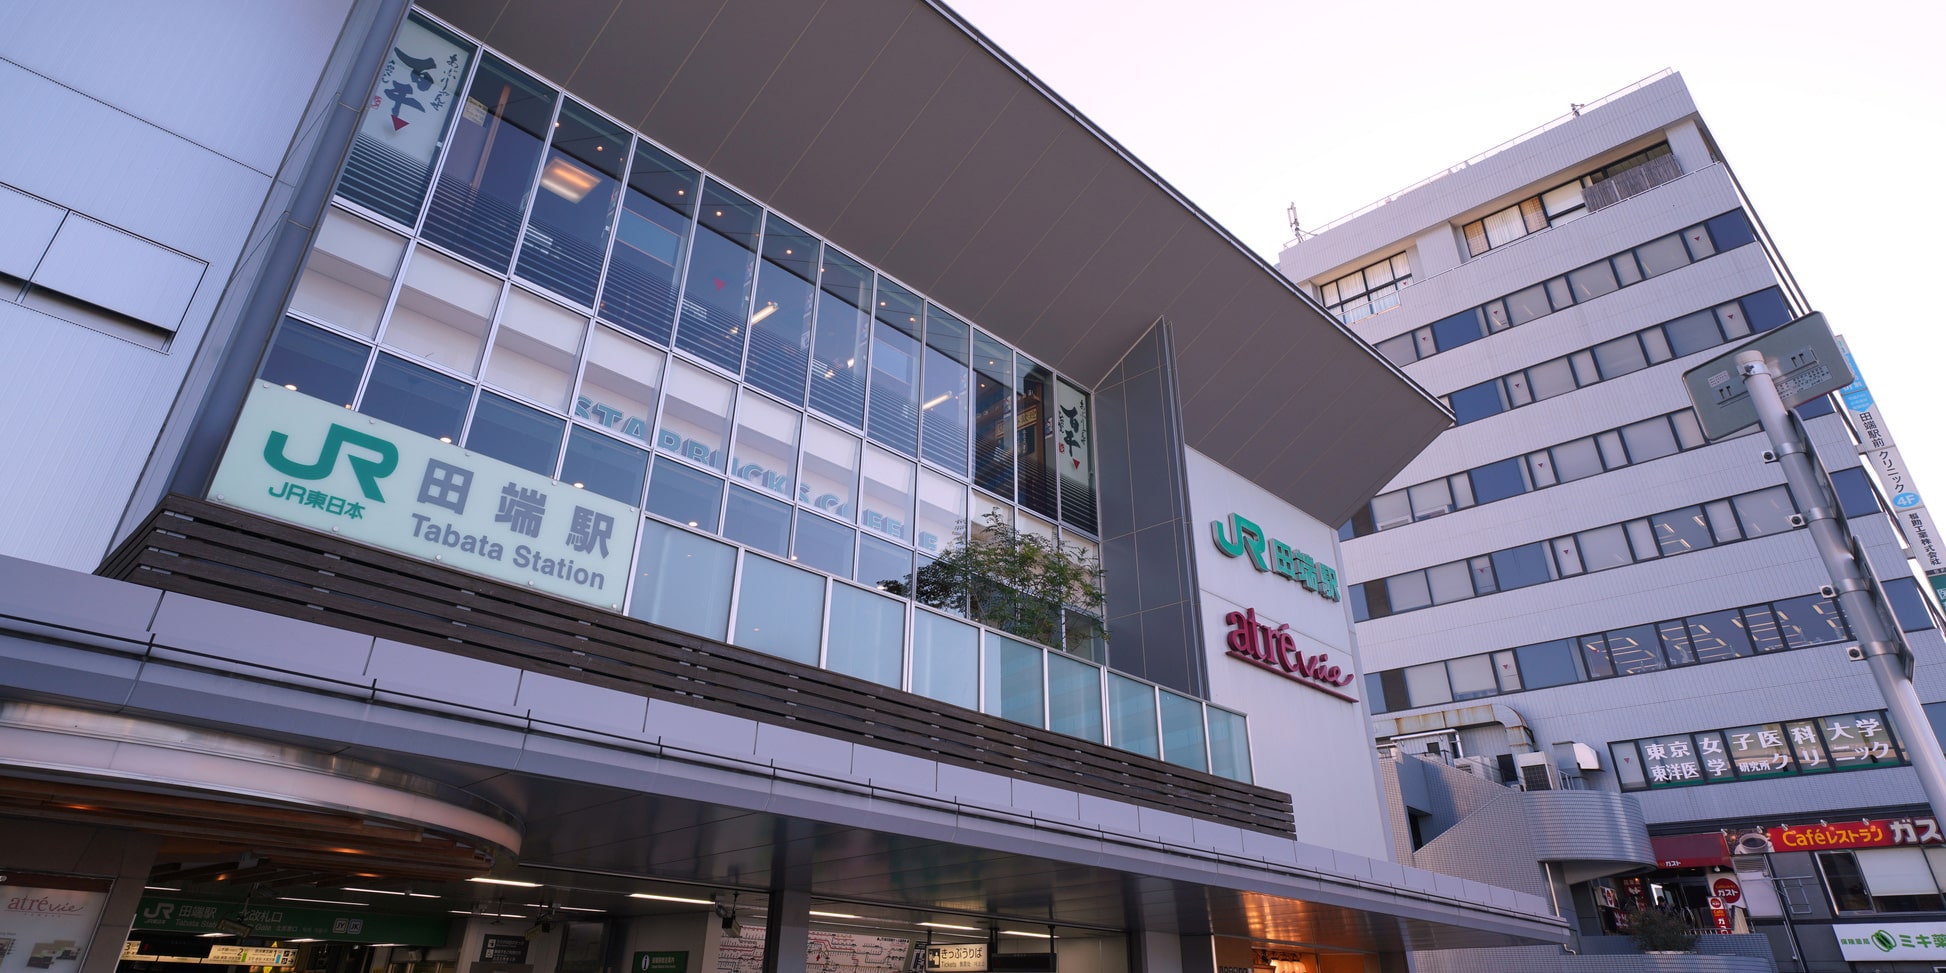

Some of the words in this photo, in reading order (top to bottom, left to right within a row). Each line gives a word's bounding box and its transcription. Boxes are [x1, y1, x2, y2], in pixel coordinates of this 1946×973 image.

[263, 423, 399, 503] JR
[268, 481, 366, 520] JR東日本
[416, 457, 615, 559] 田端駅
[1897, 494, 1917, 506] 4F
[411, 512, 501, 561] Tabata
[512, 543, 606, 590] Station
[1210, 512, 1269, 573] JR
[1268, 538, 1341, 602] 田端駅
[1644, 718, 1883, 760] 東京女子医科大学
[143, 902, 175, 919] JR
[178, 905, 217, 919] 田端駅
[1718, 889, 1739, 897] ガスト
[237, 947, 244, 956] 2
[941, 947, 982, 960] きっぷうりば
